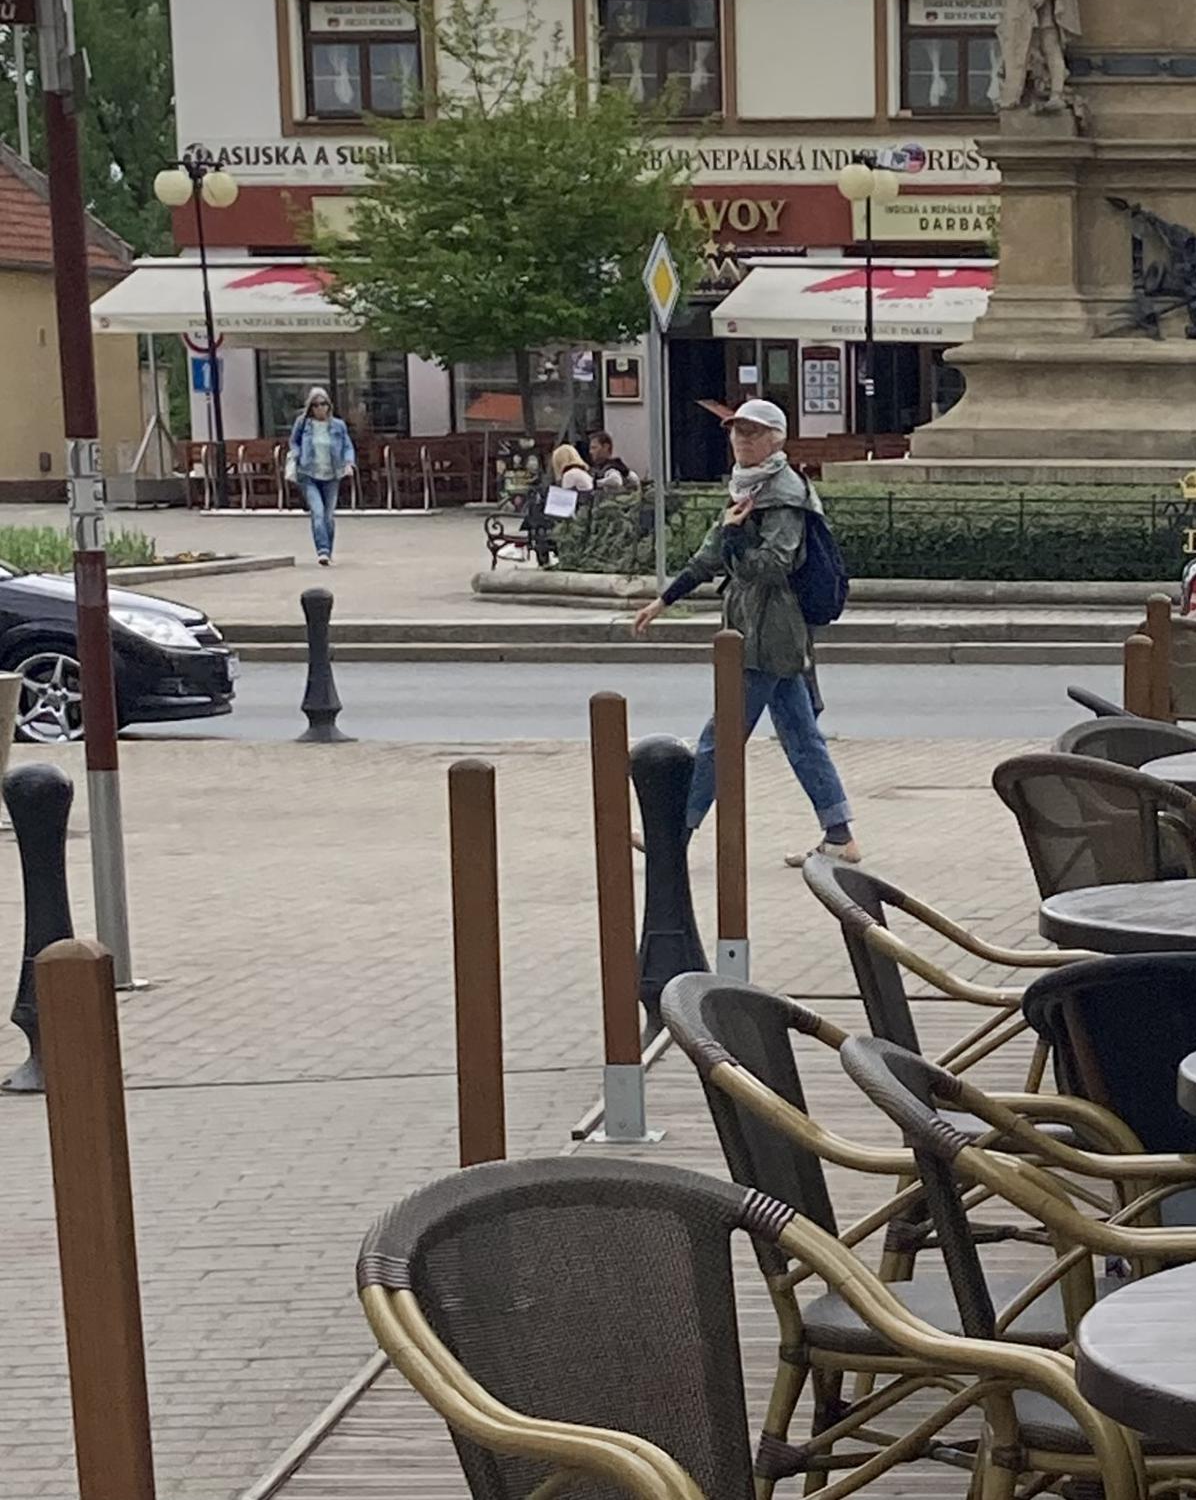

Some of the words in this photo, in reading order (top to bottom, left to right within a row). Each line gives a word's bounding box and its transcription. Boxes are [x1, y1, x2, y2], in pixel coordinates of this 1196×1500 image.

[313, 146, 330, 166] A
[699, 143, 804, 171] NEPÁLSKÁ
[674, 198, 786, 232] AVOY
[919, 217, 997, 231] DARBAR
